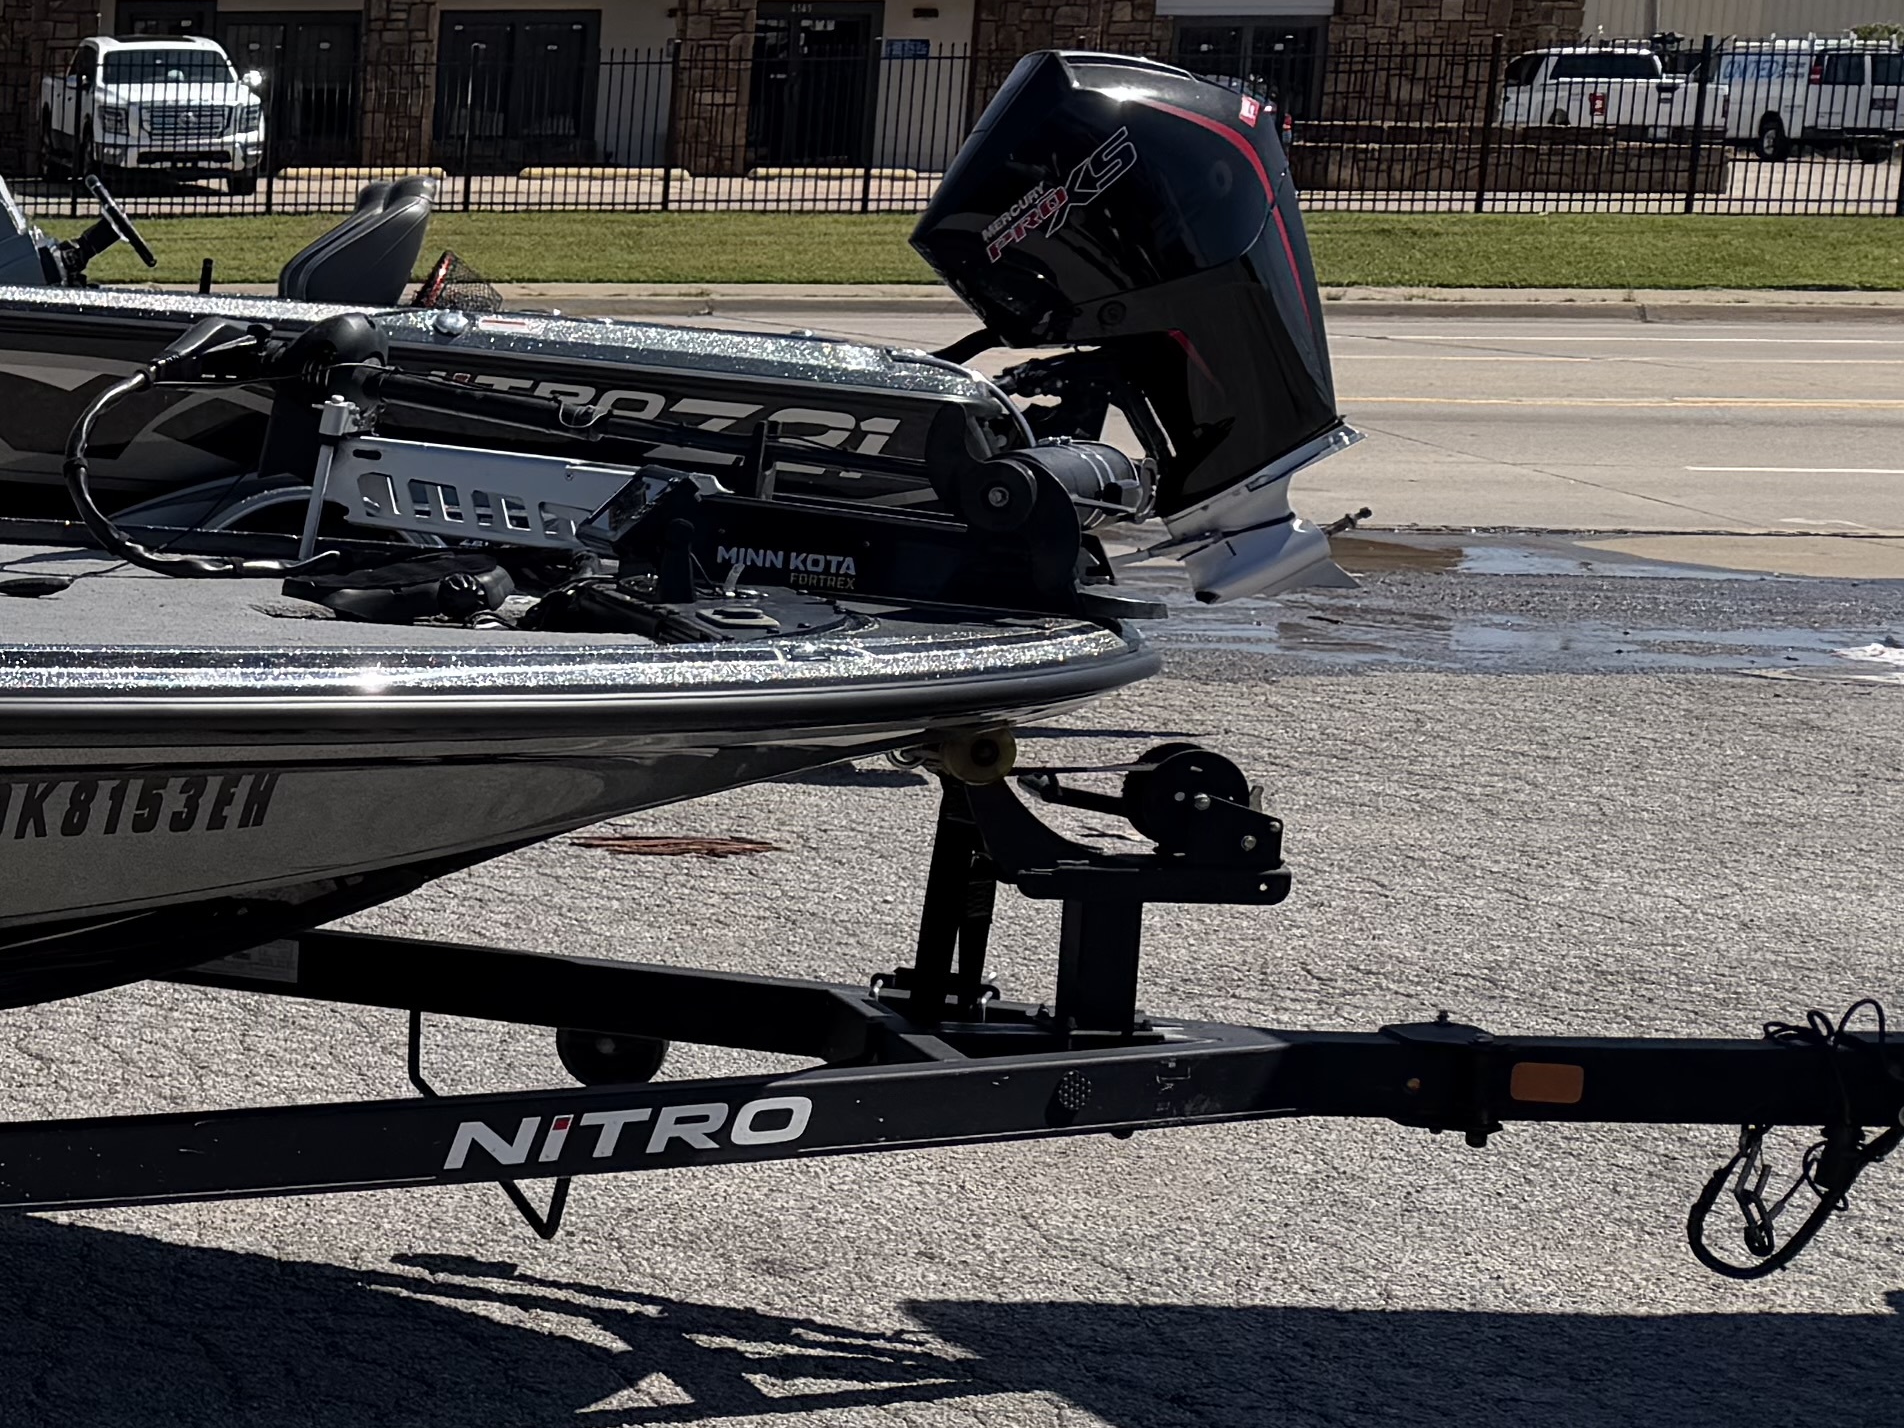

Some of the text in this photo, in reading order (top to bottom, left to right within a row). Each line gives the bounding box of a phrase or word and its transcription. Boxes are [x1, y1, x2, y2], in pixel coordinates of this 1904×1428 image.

[981, 180, 1044, 243] MERCURY
[986, 125, 1138, 263] PRO XS
[716, 545, 857, 576] MINN KOTA
[790, 573, 856, 590] FORTREX
